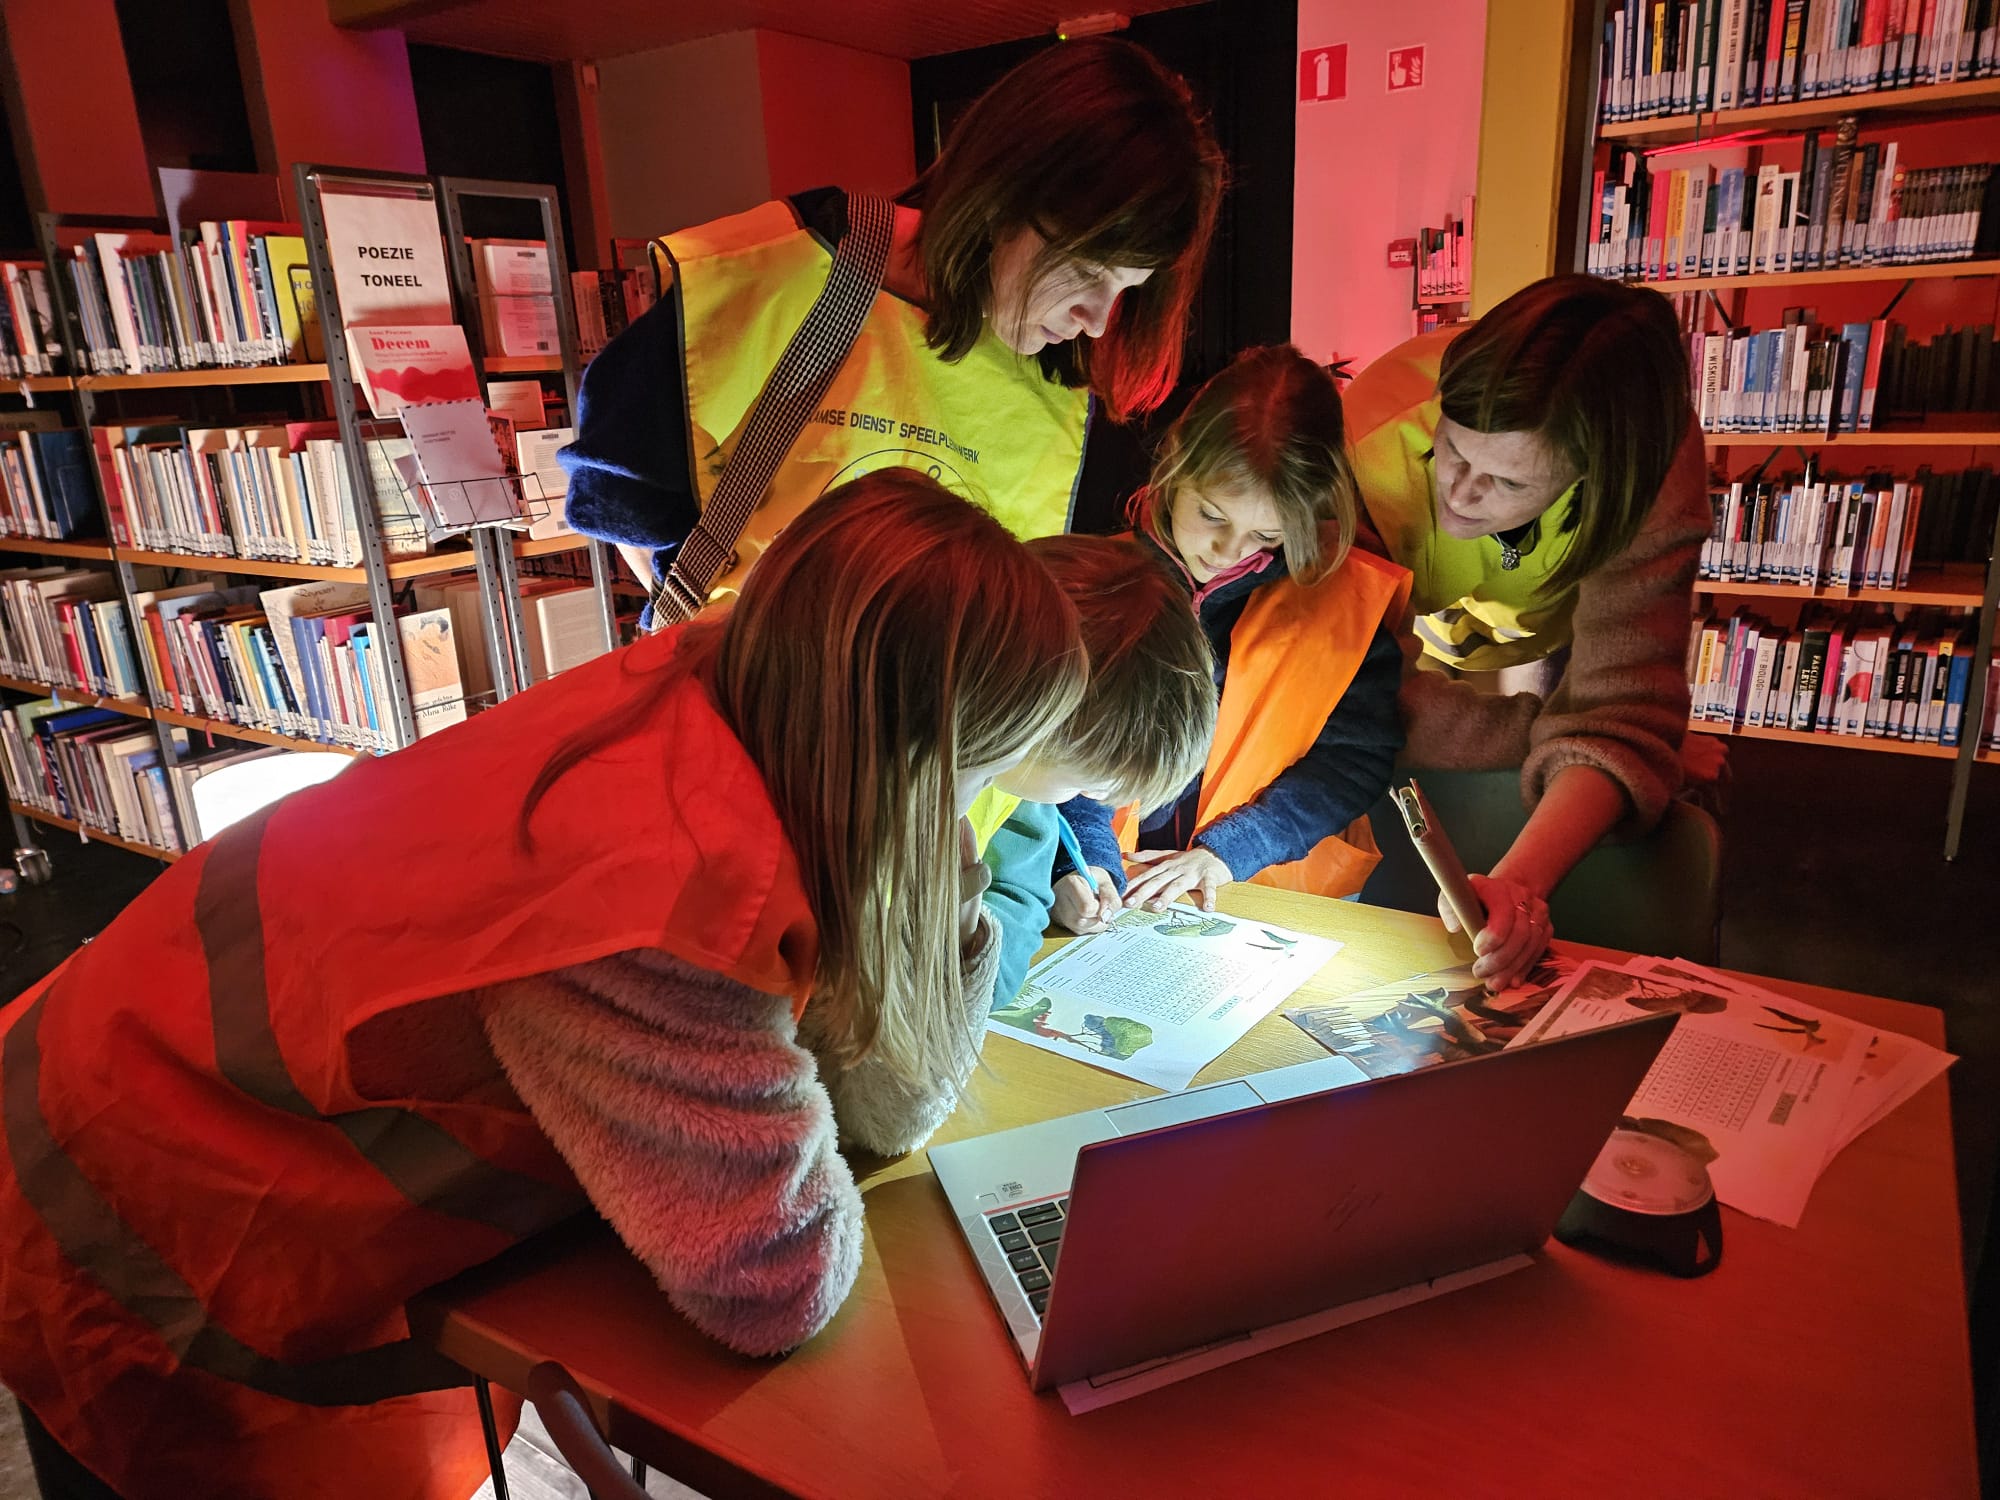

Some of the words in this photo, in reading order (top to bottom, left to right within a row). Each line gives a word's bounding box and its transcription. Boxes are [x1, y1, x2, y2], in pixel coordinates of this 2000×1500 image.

[358, 246, 415, 260] POEZIE
[361, 274, 422, 287] TONEEL
[371, 337, 431, 350] Decem
[1707, 355, 1718, 393] WISKUND
[850, 412, 895, 434] DIENST
[1895, 675, 1905, 694] DNA
